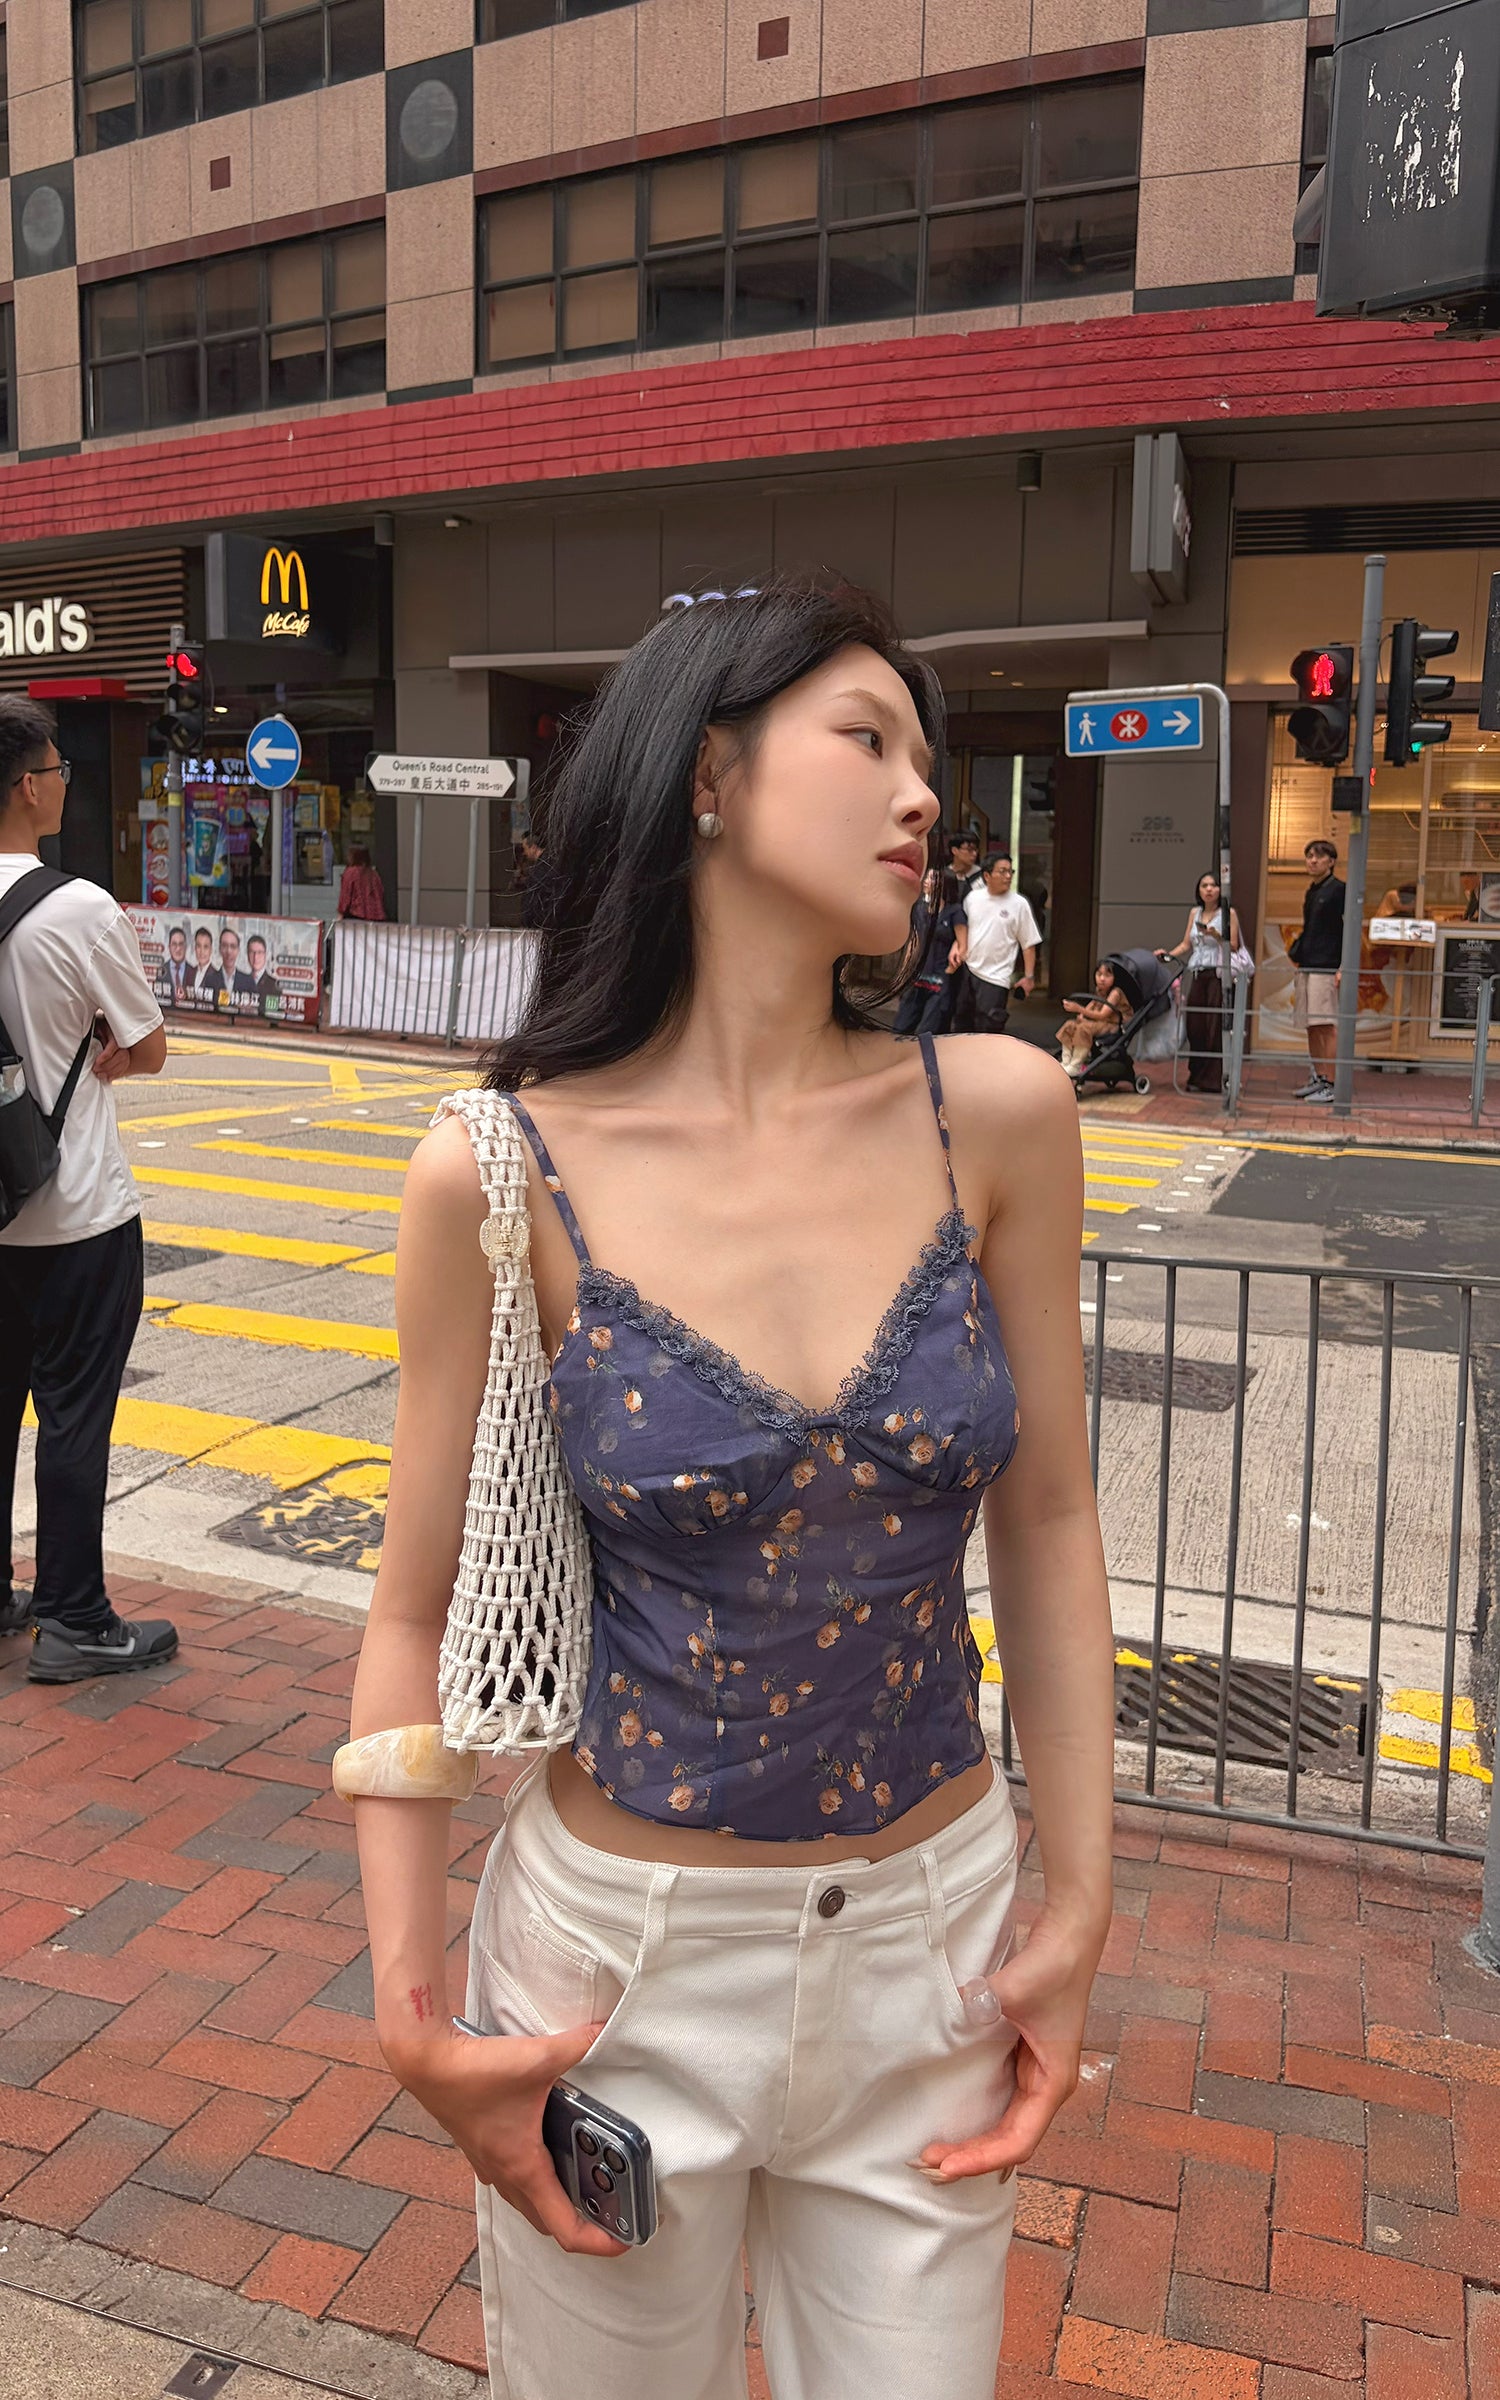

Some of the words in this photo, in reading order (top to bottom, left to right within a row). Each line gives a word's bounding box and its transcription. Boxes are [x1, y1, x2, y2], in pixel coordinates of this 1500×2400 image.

[392, 760, 426, 772] Queen's
[430, 762, 453, 773] Road
[455, 763, 489, 774] Central
[410, 776, 470, 792] 皇后大道中
